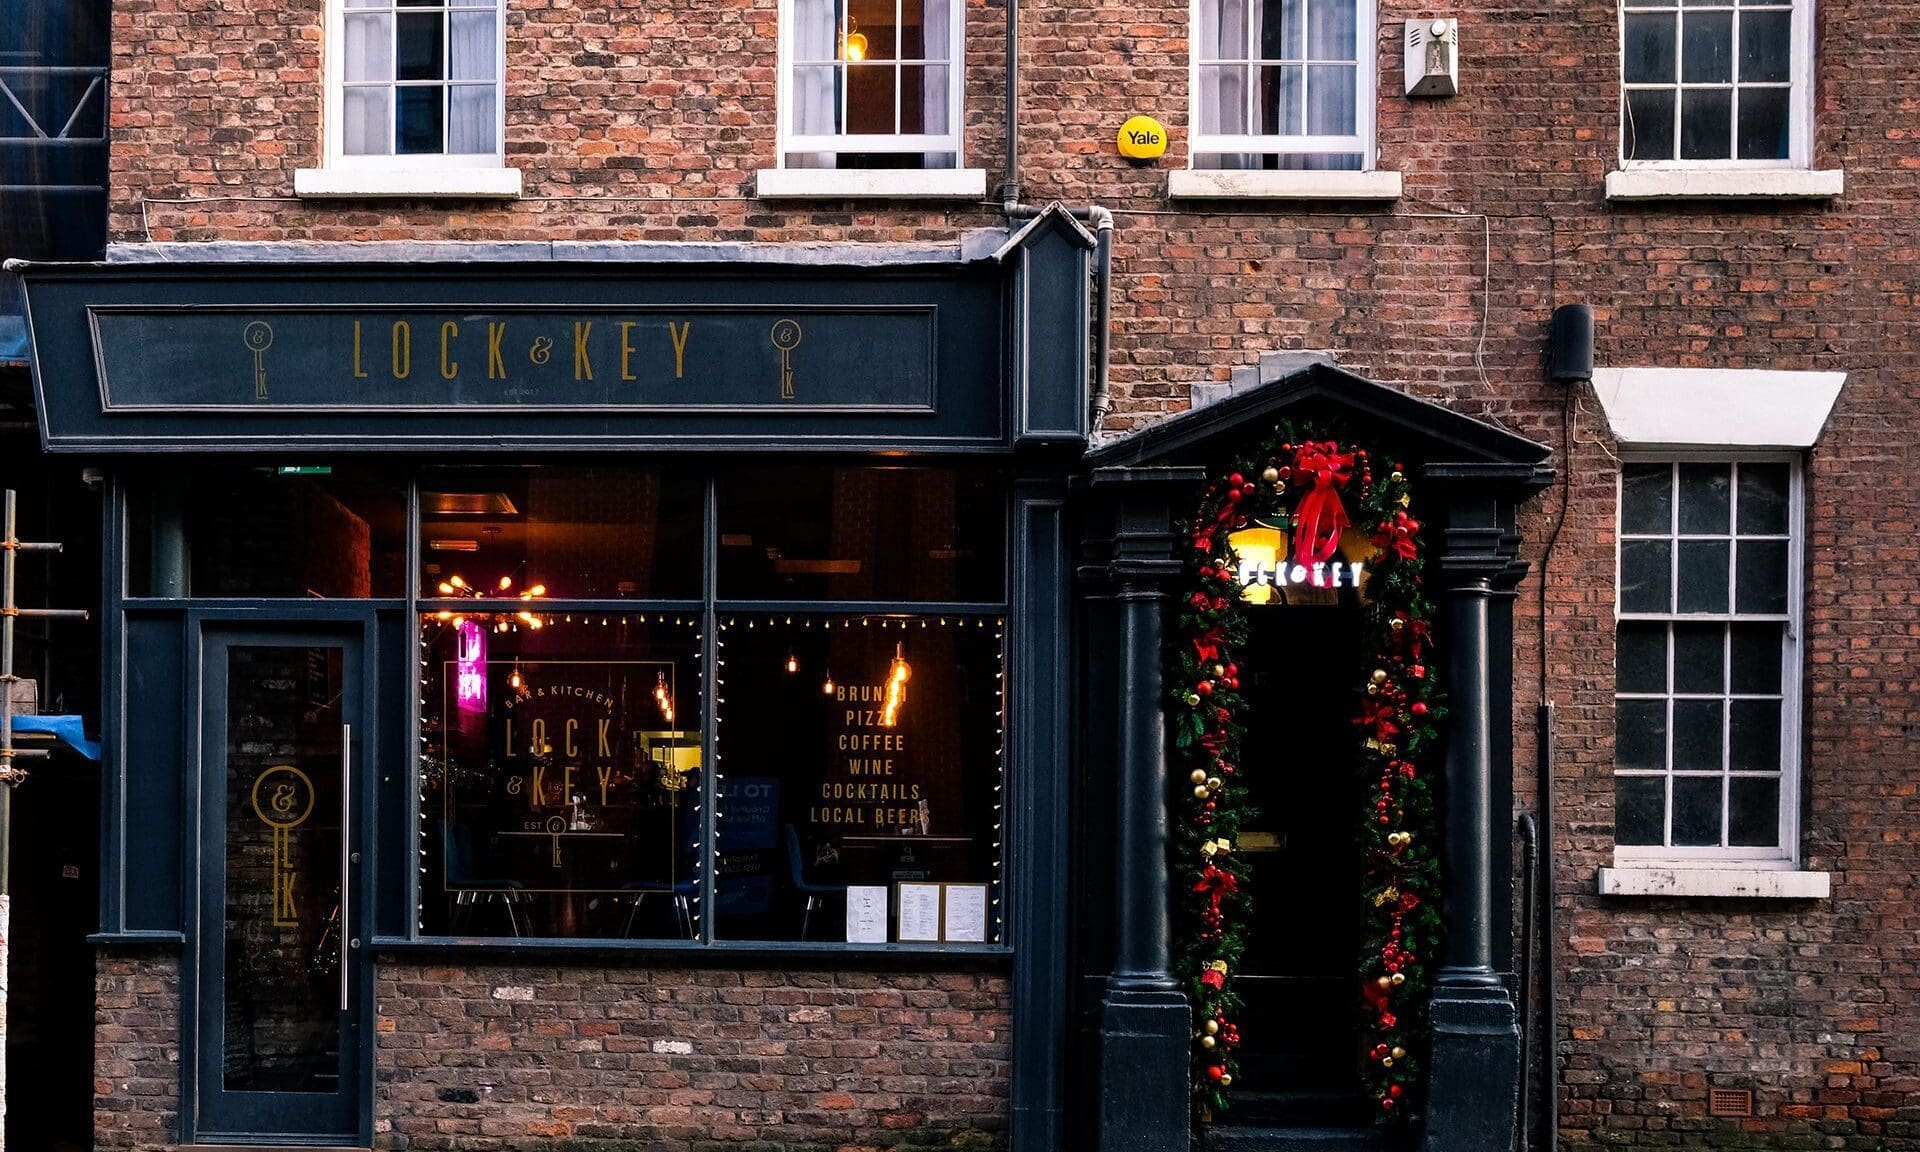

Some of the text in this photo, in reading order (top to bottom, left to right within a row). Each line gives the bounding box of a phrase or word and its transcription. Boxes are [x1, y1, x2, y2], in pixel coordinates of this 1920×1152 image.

[1128, 131, 1159, 145] Yale
[354, 320, 690, 381] LOCK & KEY
[1312, 561, 1364, 588] KEY
[505, 686, 614, 709] BAR & KITCHEN
[506, 718, 611, 757] LOCK
[839, 734, 904, 750] COFFEE
[849, 759, 893, 775] WINE
[507, 766, 612, 806] & KEY
[822, 783, 920, 800] COCKTAILS
[272, 784, 295, 812] &
[524, 821, 542, 830] EST
[811, 808, 864, 824] LOCAL
